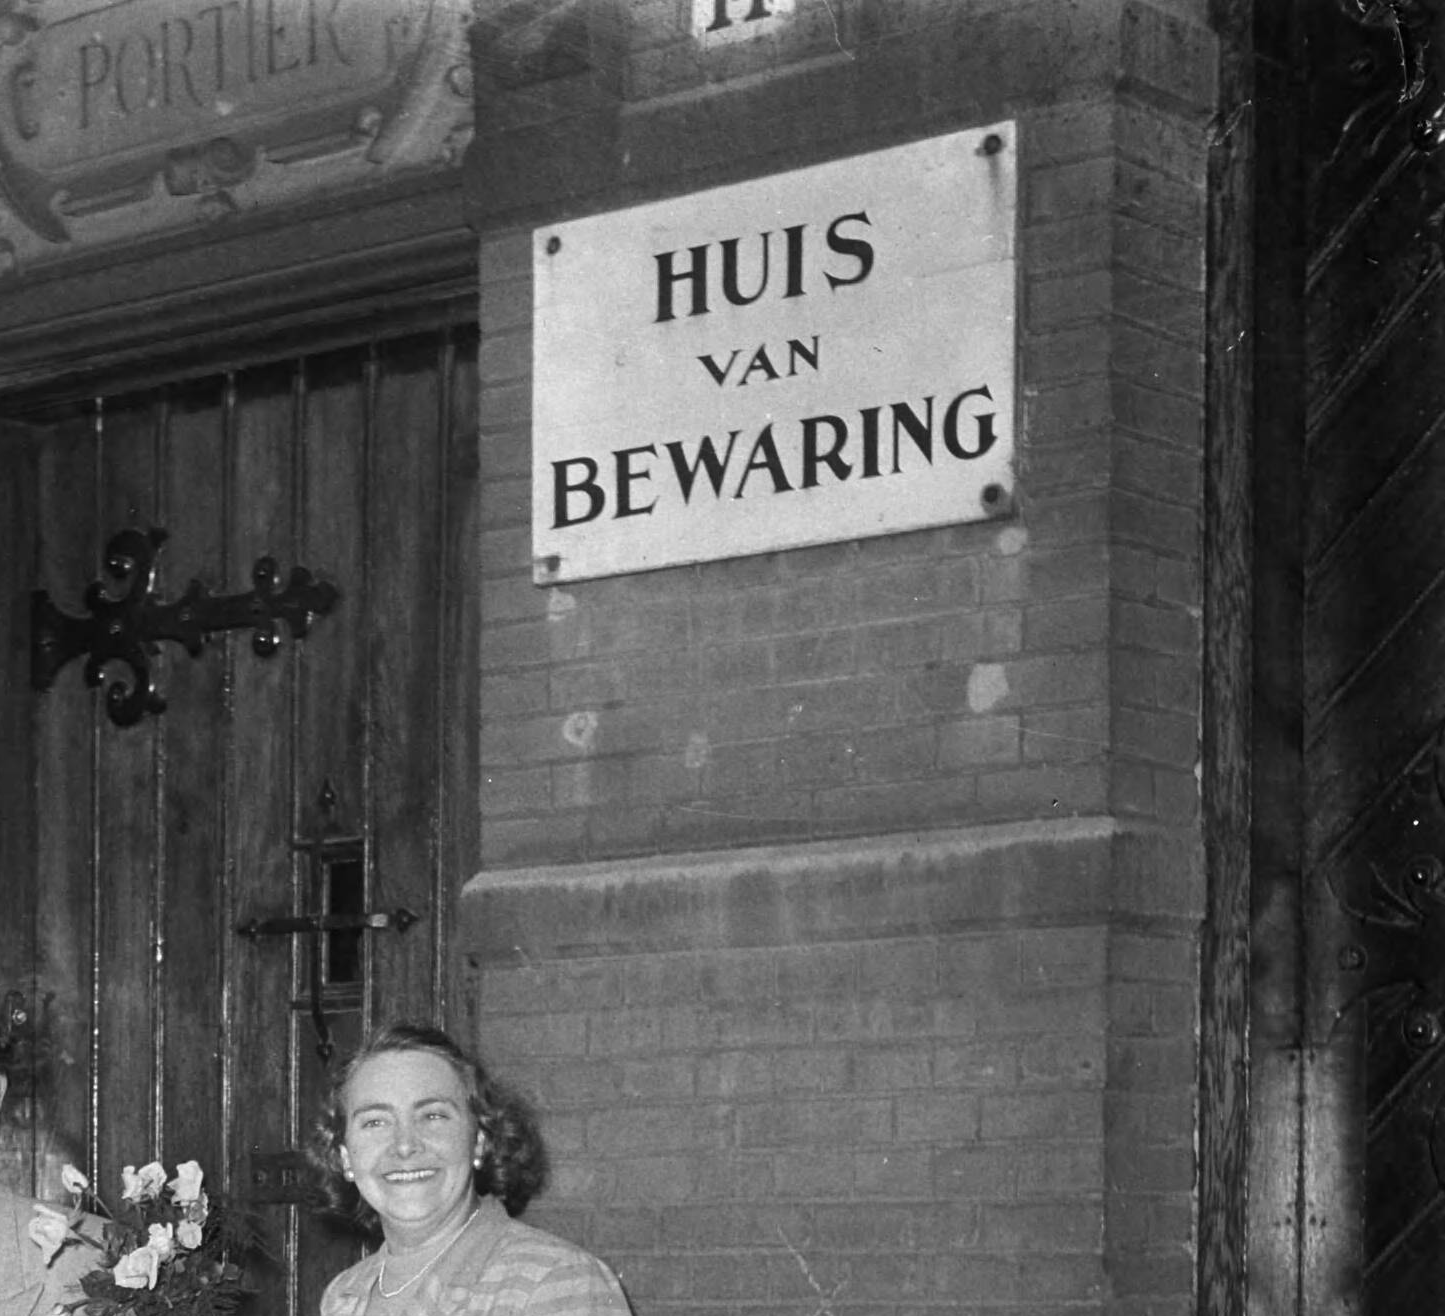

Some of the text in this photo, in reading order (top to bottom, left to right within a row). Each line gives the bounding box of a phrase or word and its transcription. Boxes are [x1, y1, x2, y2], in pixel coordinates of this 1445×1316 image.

[78, 0, 352, 128] PORTIER
[653, 211, 874, 323] HUIS
[697, 335, 820, 387] VAN
[551, 384, 998, 530] BEWARING
